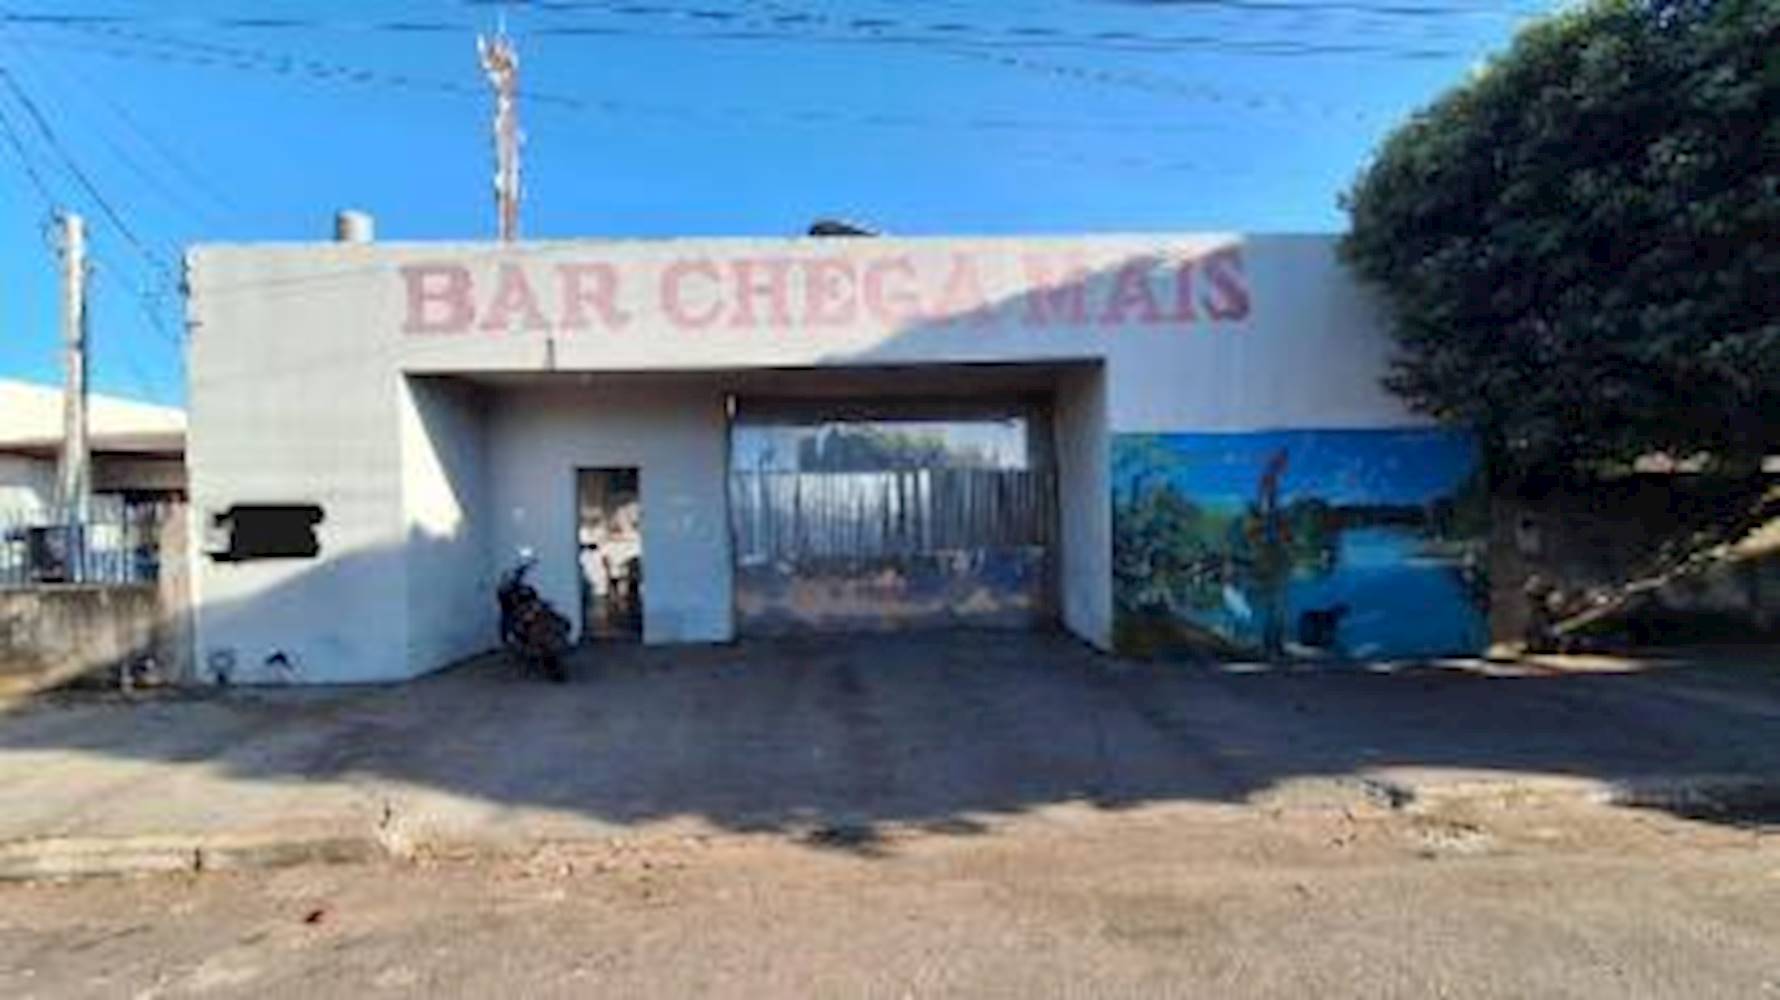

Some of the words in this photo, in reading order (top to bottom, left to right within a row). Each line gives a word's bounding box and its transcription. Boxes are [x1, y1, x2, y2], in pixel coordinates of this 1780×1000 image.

[402, 262, 631, 334] BAR
[659, 257, 998, 330] CHEGA
[1019, 248, 1251, 326] MAIS
